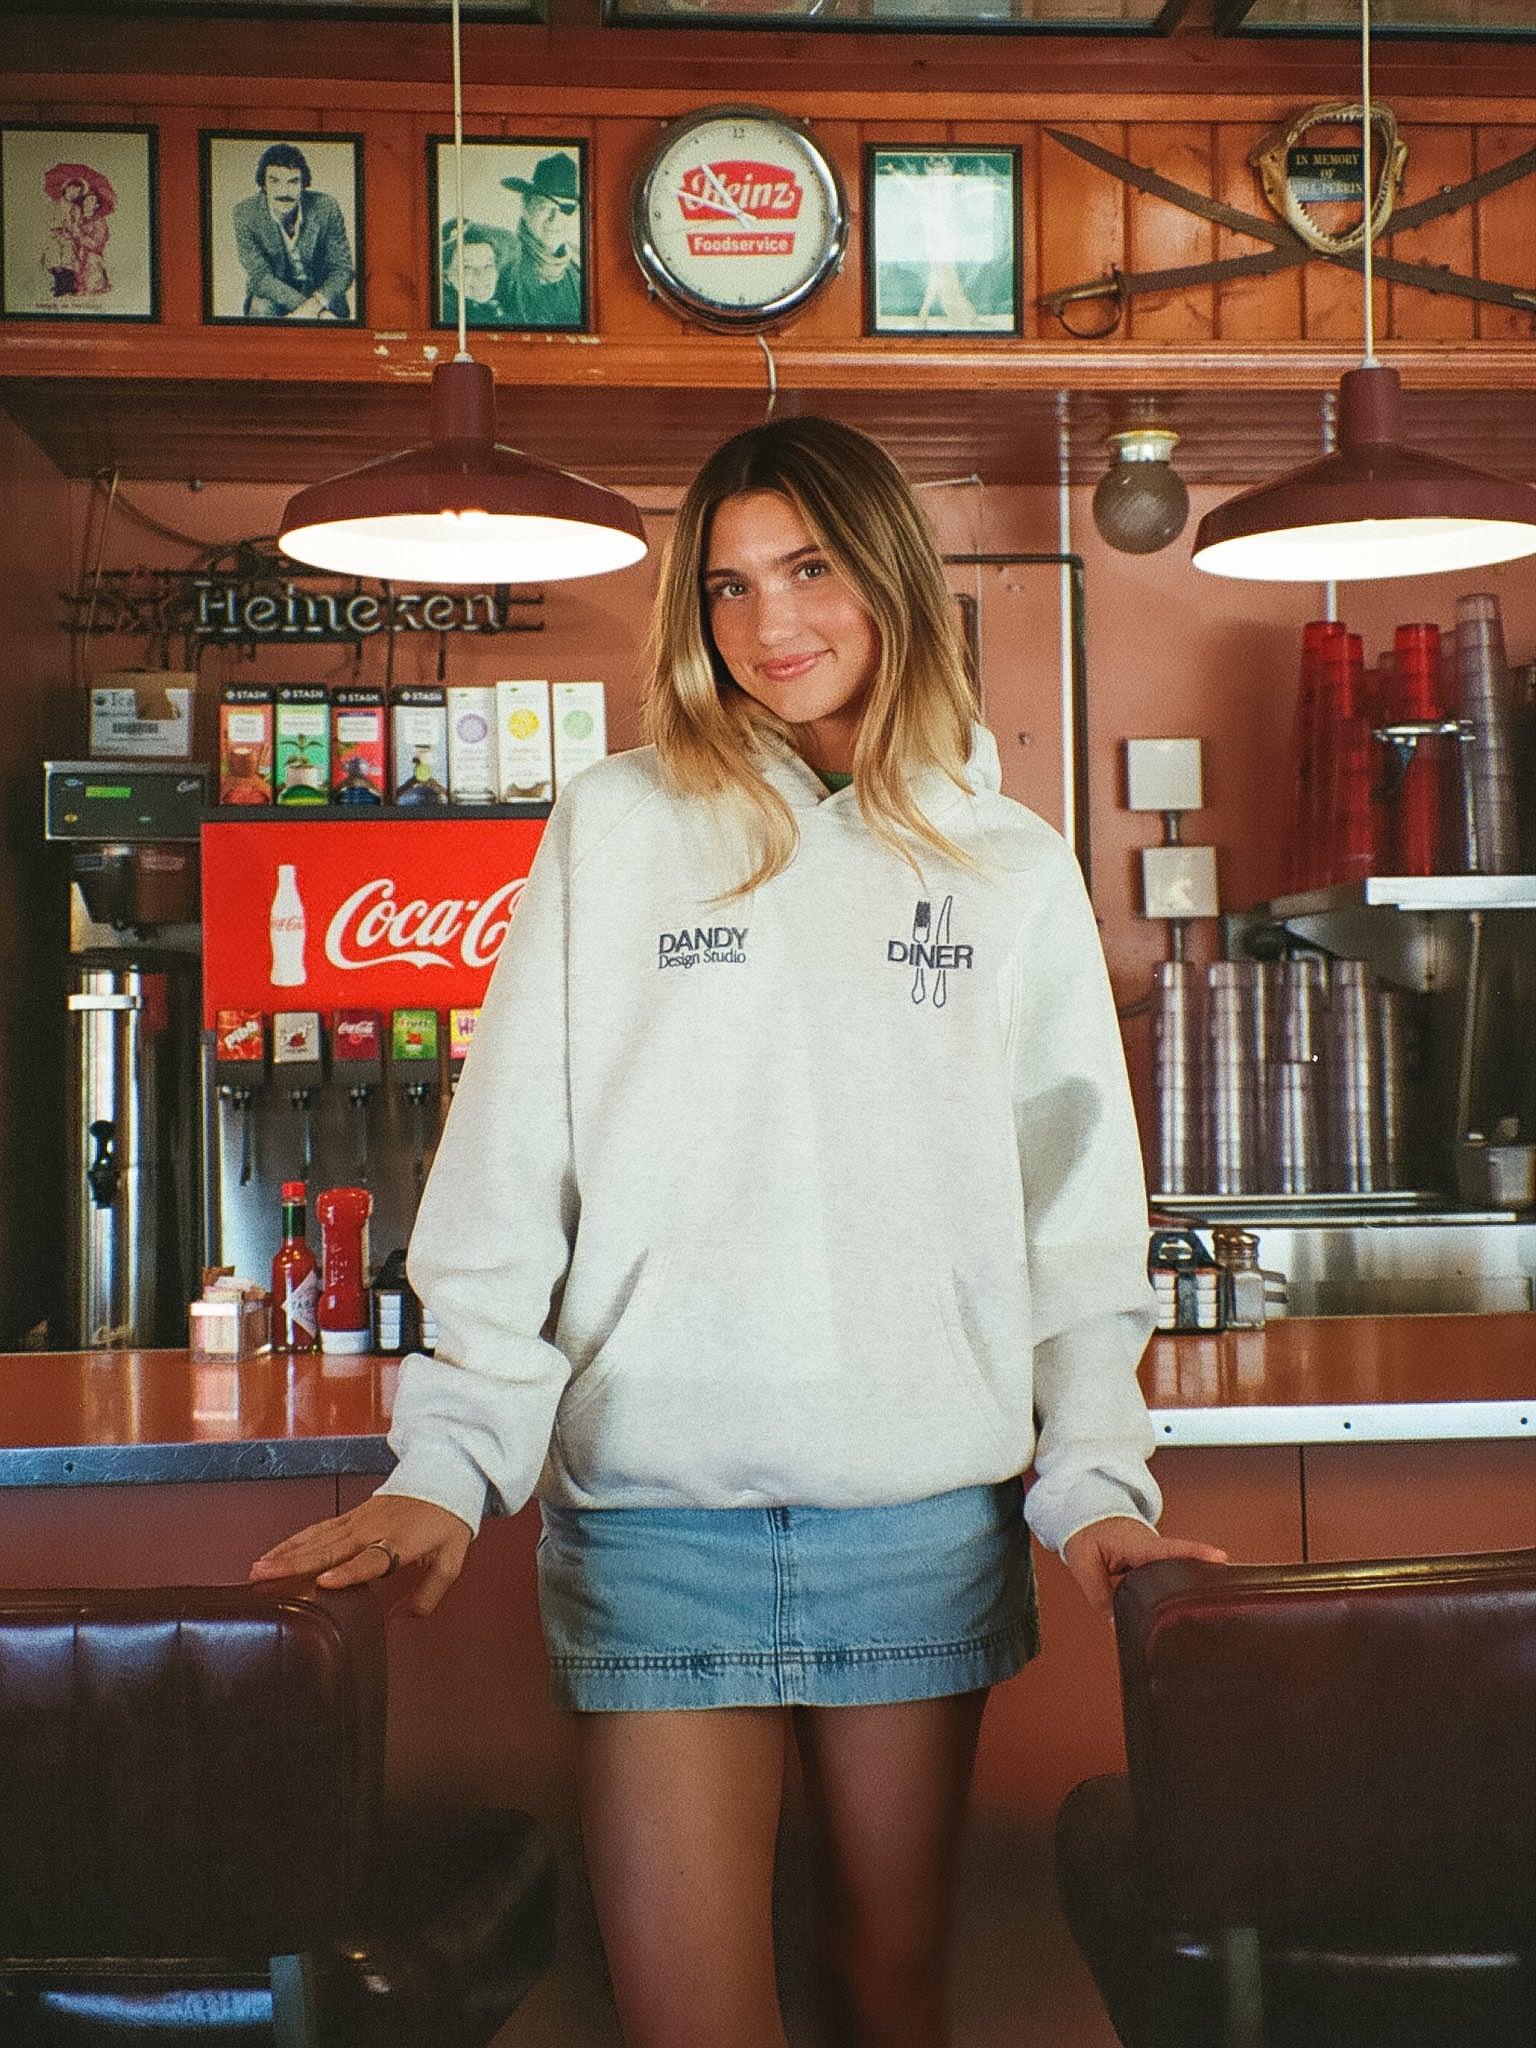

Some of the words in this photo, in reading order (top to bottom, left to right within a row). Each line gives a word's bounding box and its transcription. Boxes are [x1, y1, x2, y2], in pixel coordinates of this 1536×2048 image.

[733, 127, 745, 139] 12
[1295, 154, 1309, 166] IN
[1312, 154, 1360, 166] MEMORY
[685, 172, 796, 211] Heinz
[693, 236, 789, 253] Foodservice
[194, 581, 502, 633] Heineken
[325, 878, 528, 969] Coca-C
[658, 927, 749, 954] DANDY
[658, 953, 700, 969] Design
[703, 947, 746, 964] Studio
[887, 940, 974, 969] DINER
